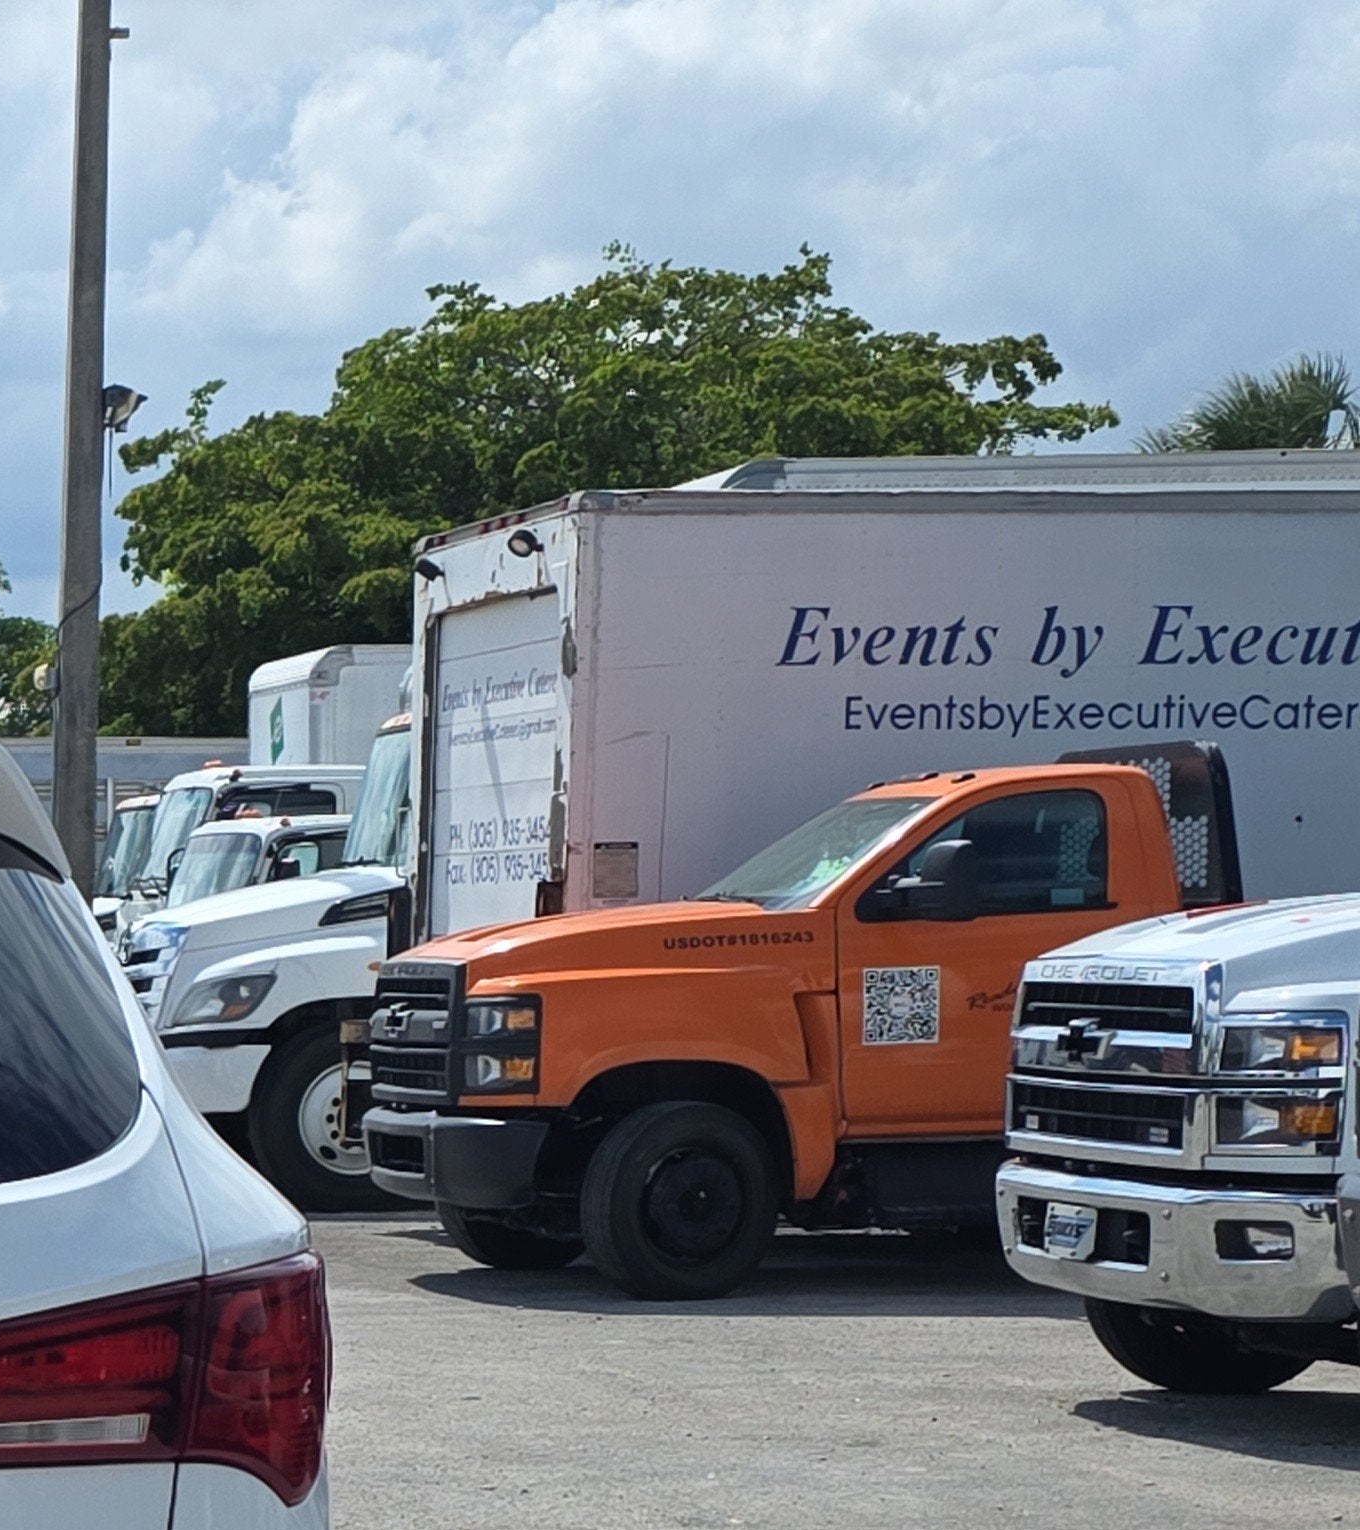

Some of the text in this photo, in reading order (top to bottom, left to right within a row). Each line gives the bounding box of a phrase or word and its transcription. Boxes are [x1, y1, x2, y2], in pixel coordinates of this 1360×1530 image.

[775, 605, 999, 667] Events
[1030, 606, 1105, 678] by
[663, 930, 814, 950] USDOT#1816243
